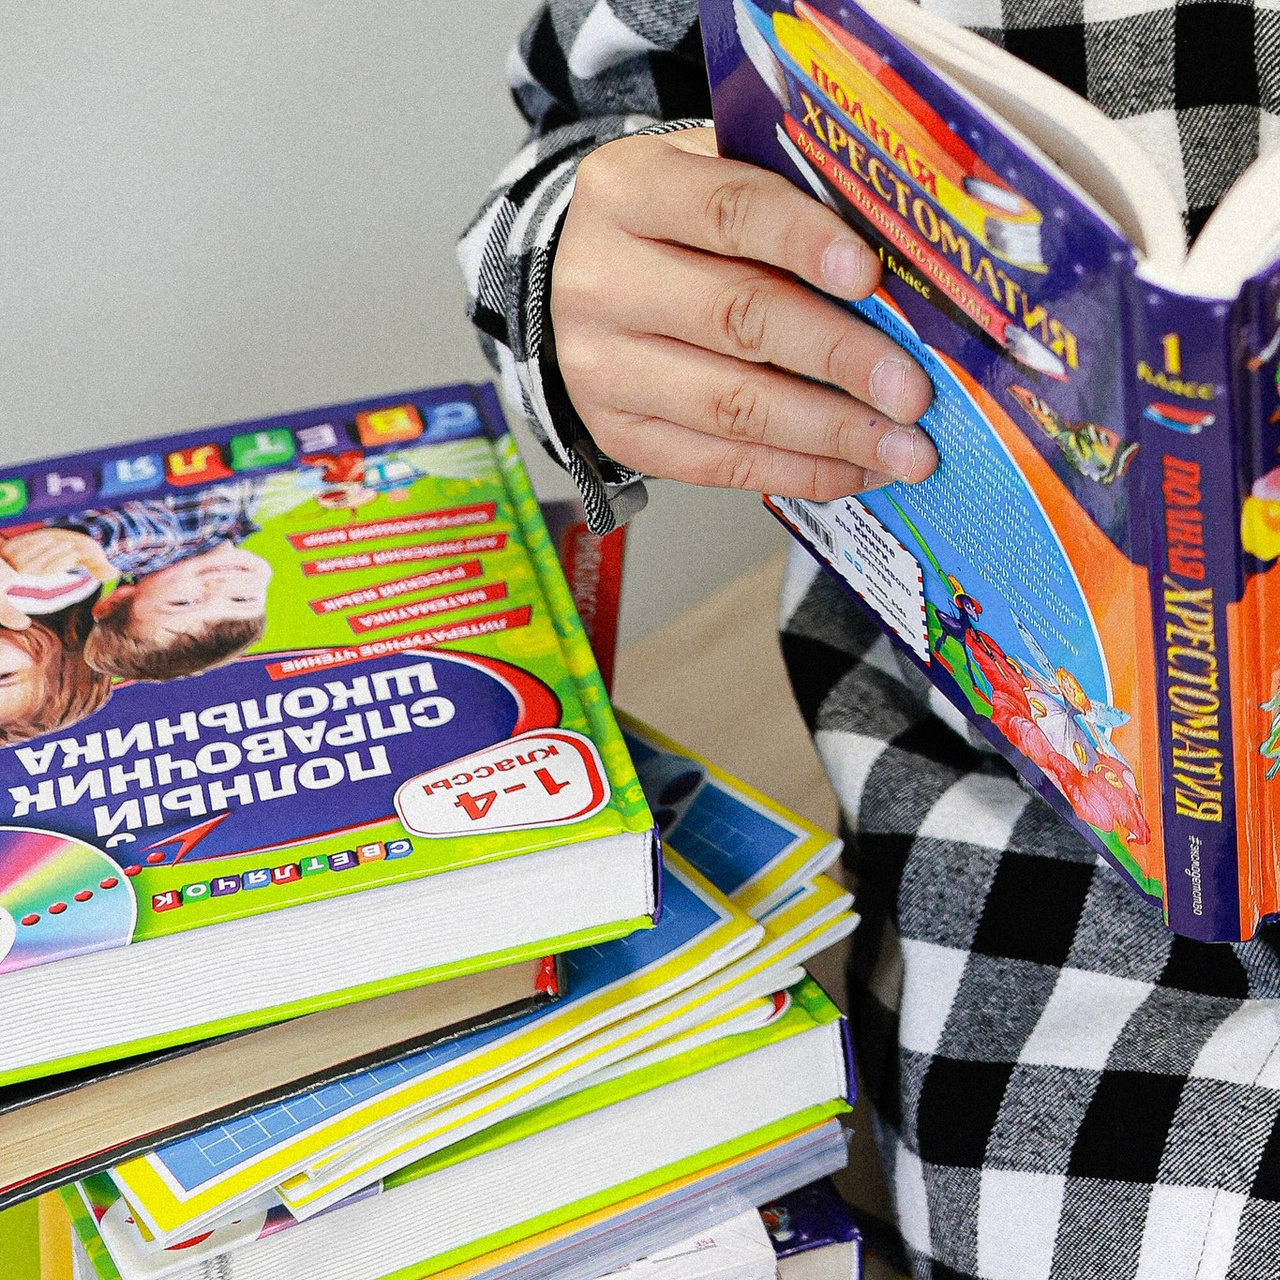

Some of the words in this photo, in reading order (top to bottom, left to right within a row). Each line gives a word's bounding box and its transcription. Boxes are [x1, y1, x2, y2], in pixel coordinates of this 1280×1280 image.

[795, 127, 828, 169] для
[809, 57, 939, 201] ПОЛНАЯ
[796, 85, 1081, 377] ХРЕСТОМАТИЯ
[885, 249, 932, 305] класс
[1161, 333, 1182, 375] 1
[1137, 363, 1217, 400] класс
[842, 497, 897, 562] Хорошие
[852, 520, 890, 566] книги
[1161, 456, 1205, 579] ПОЛНАЯ
[378, 566, 467, 598] РУССКИЙ
[833, 512, 853, 538] для
[851, 531, 913, 600] счастливого
[853, 543, 893, 590] детства
[321, 587, 377, 611] ЯЗЫК
[358, 590, 487, 628] МАТЕМАТИКА
[280, 648, 357, 673] ЧТЕНИЕ
[359, 617, 508, 656] ЛИТЕРАТУРНОЕ
[14, 662, 438, 775] ШКОЛЬНИКА
[1161, 576, 1222, 823] ХРЕСТОМАТИЯ
[7, 695, 456, 818] СПРАВОЧНИК
[421, 744, 560, 796] классы
[90, 746, 392, 848] ПОЛНЫЙ
[454, 768, 571, 822] 1-4
[154, 841, 410, 911] СВЕТЛЯЧОК
